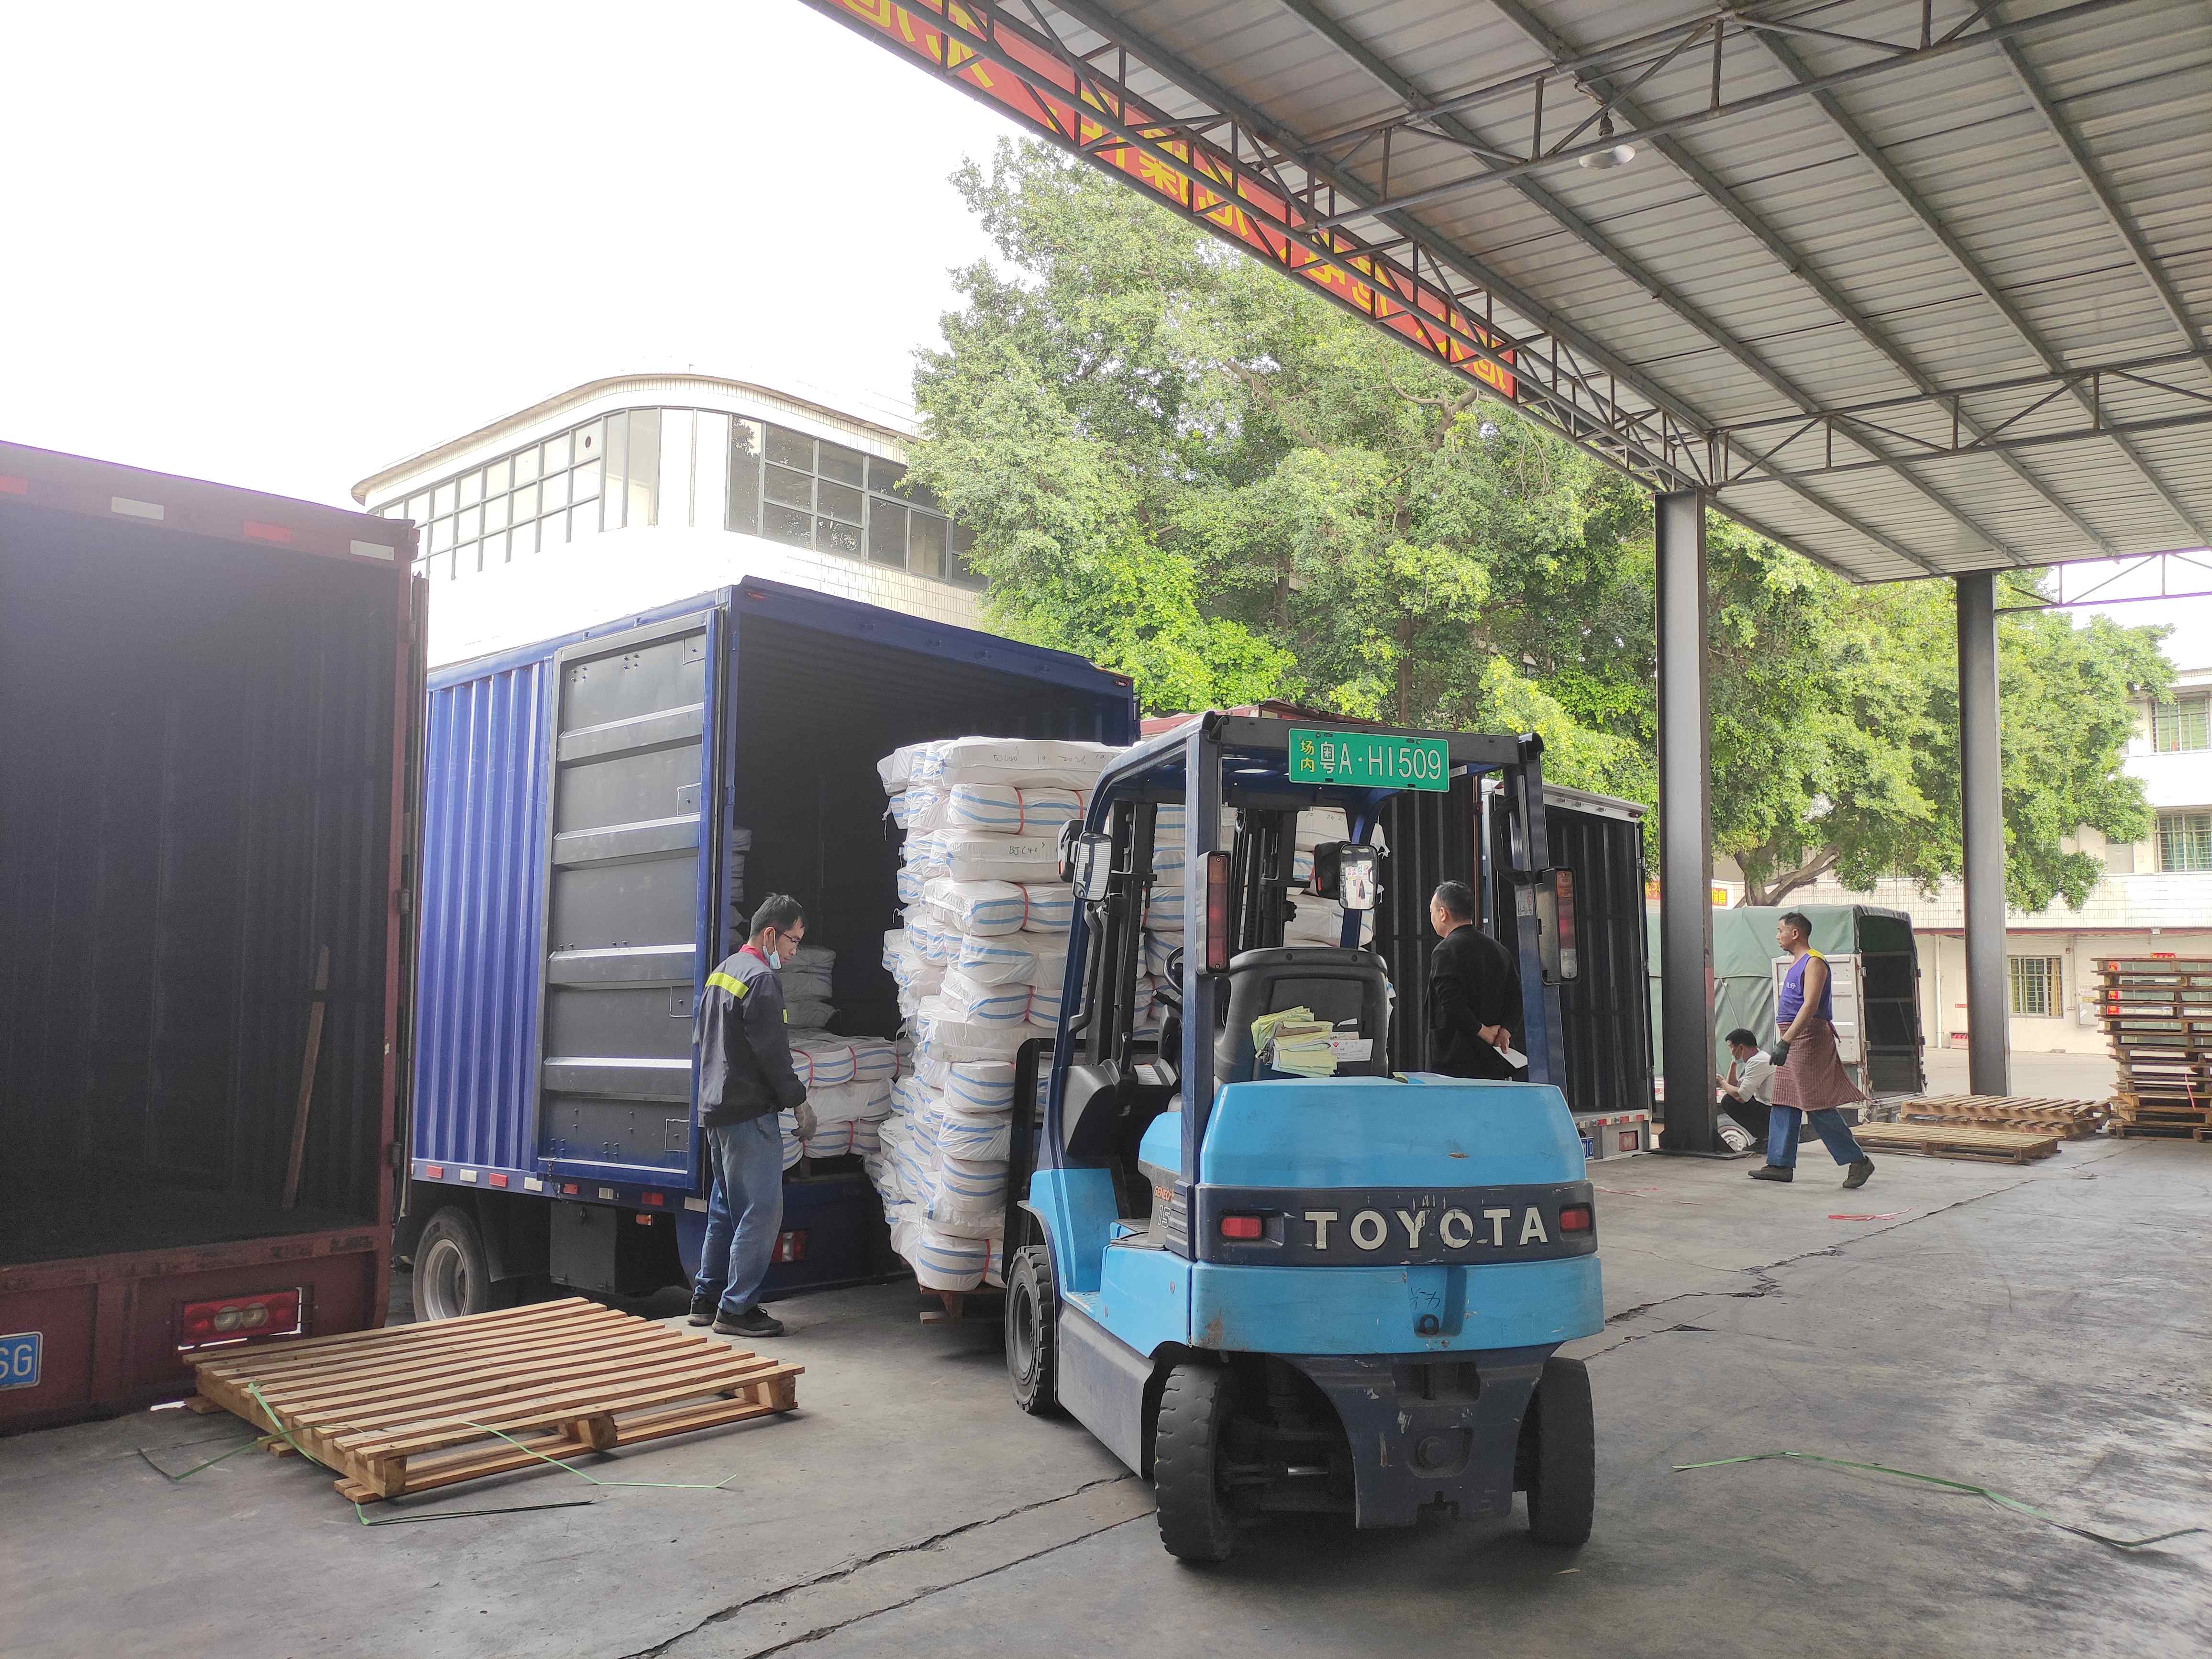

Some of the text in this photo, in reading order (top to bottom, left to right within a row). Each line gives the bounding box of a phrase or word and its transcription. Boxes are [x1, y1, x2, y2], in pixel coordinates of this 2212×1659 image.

[1300, 740, 1315, 773] 场内
[1158, 1205, 1172, 1229] 15
[1305, 1206, 1548, 1250] TOYOTA
